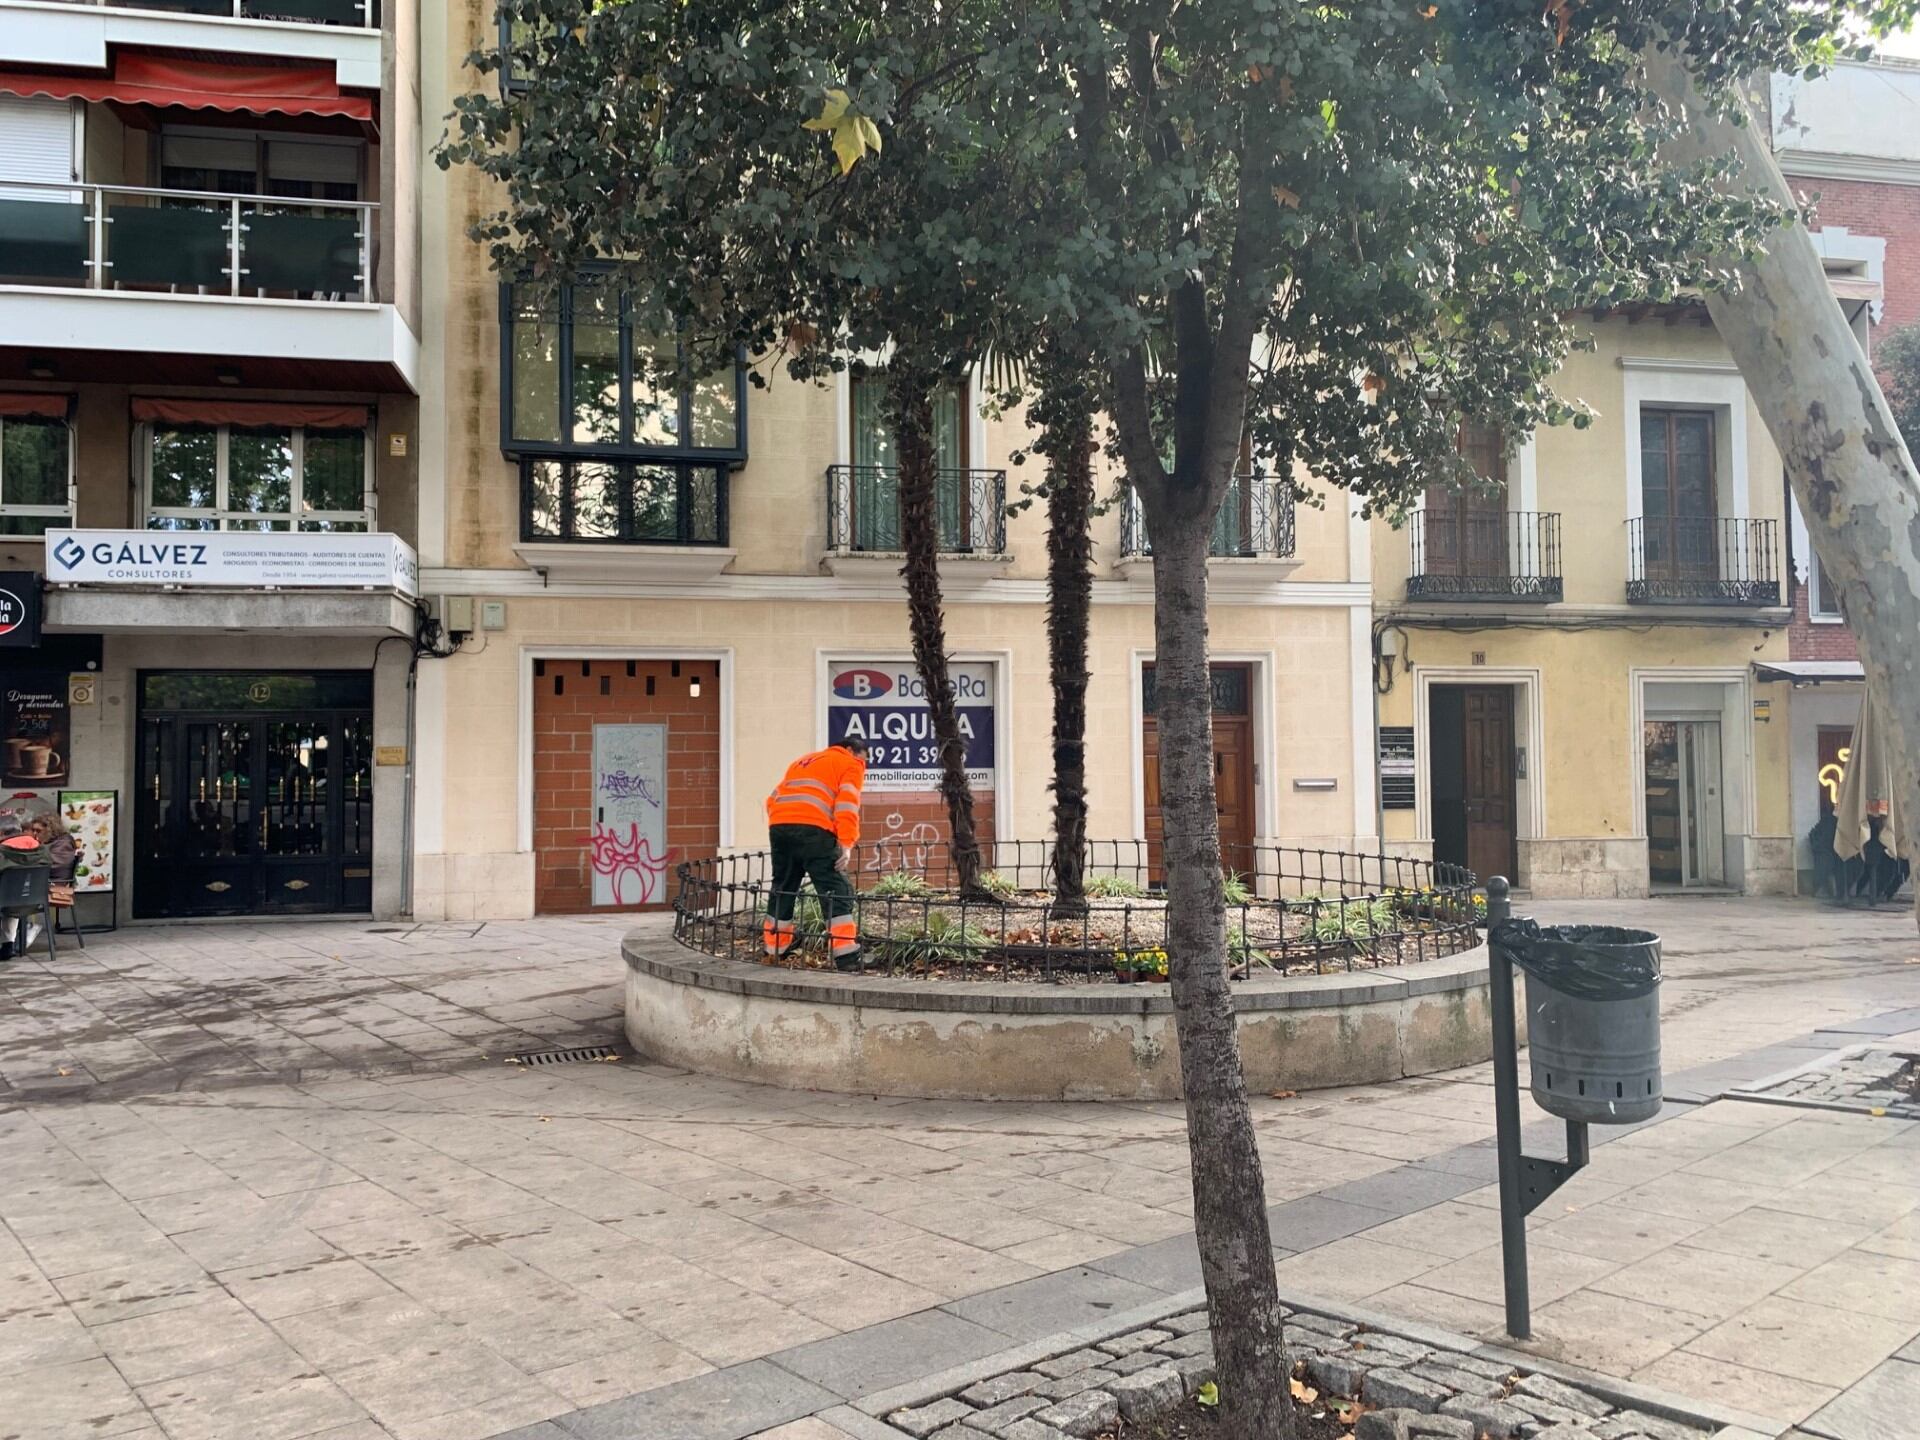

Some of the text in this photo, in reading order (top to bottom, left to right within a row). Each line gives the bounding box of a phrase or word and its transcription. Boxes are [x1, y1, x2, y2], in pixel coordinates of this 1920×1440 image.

[92, 541, 207, 565] GÁLVEZ
[108, 570, 193, 578] CONSULTORES
[1475, 654, 1484, 664] 10
[254, 687, 267, 698] 12
[844, 713, 975, 741] ALQUIA
[891, 746, 910, 764] 21
[919, 746, 938, 764] 39
